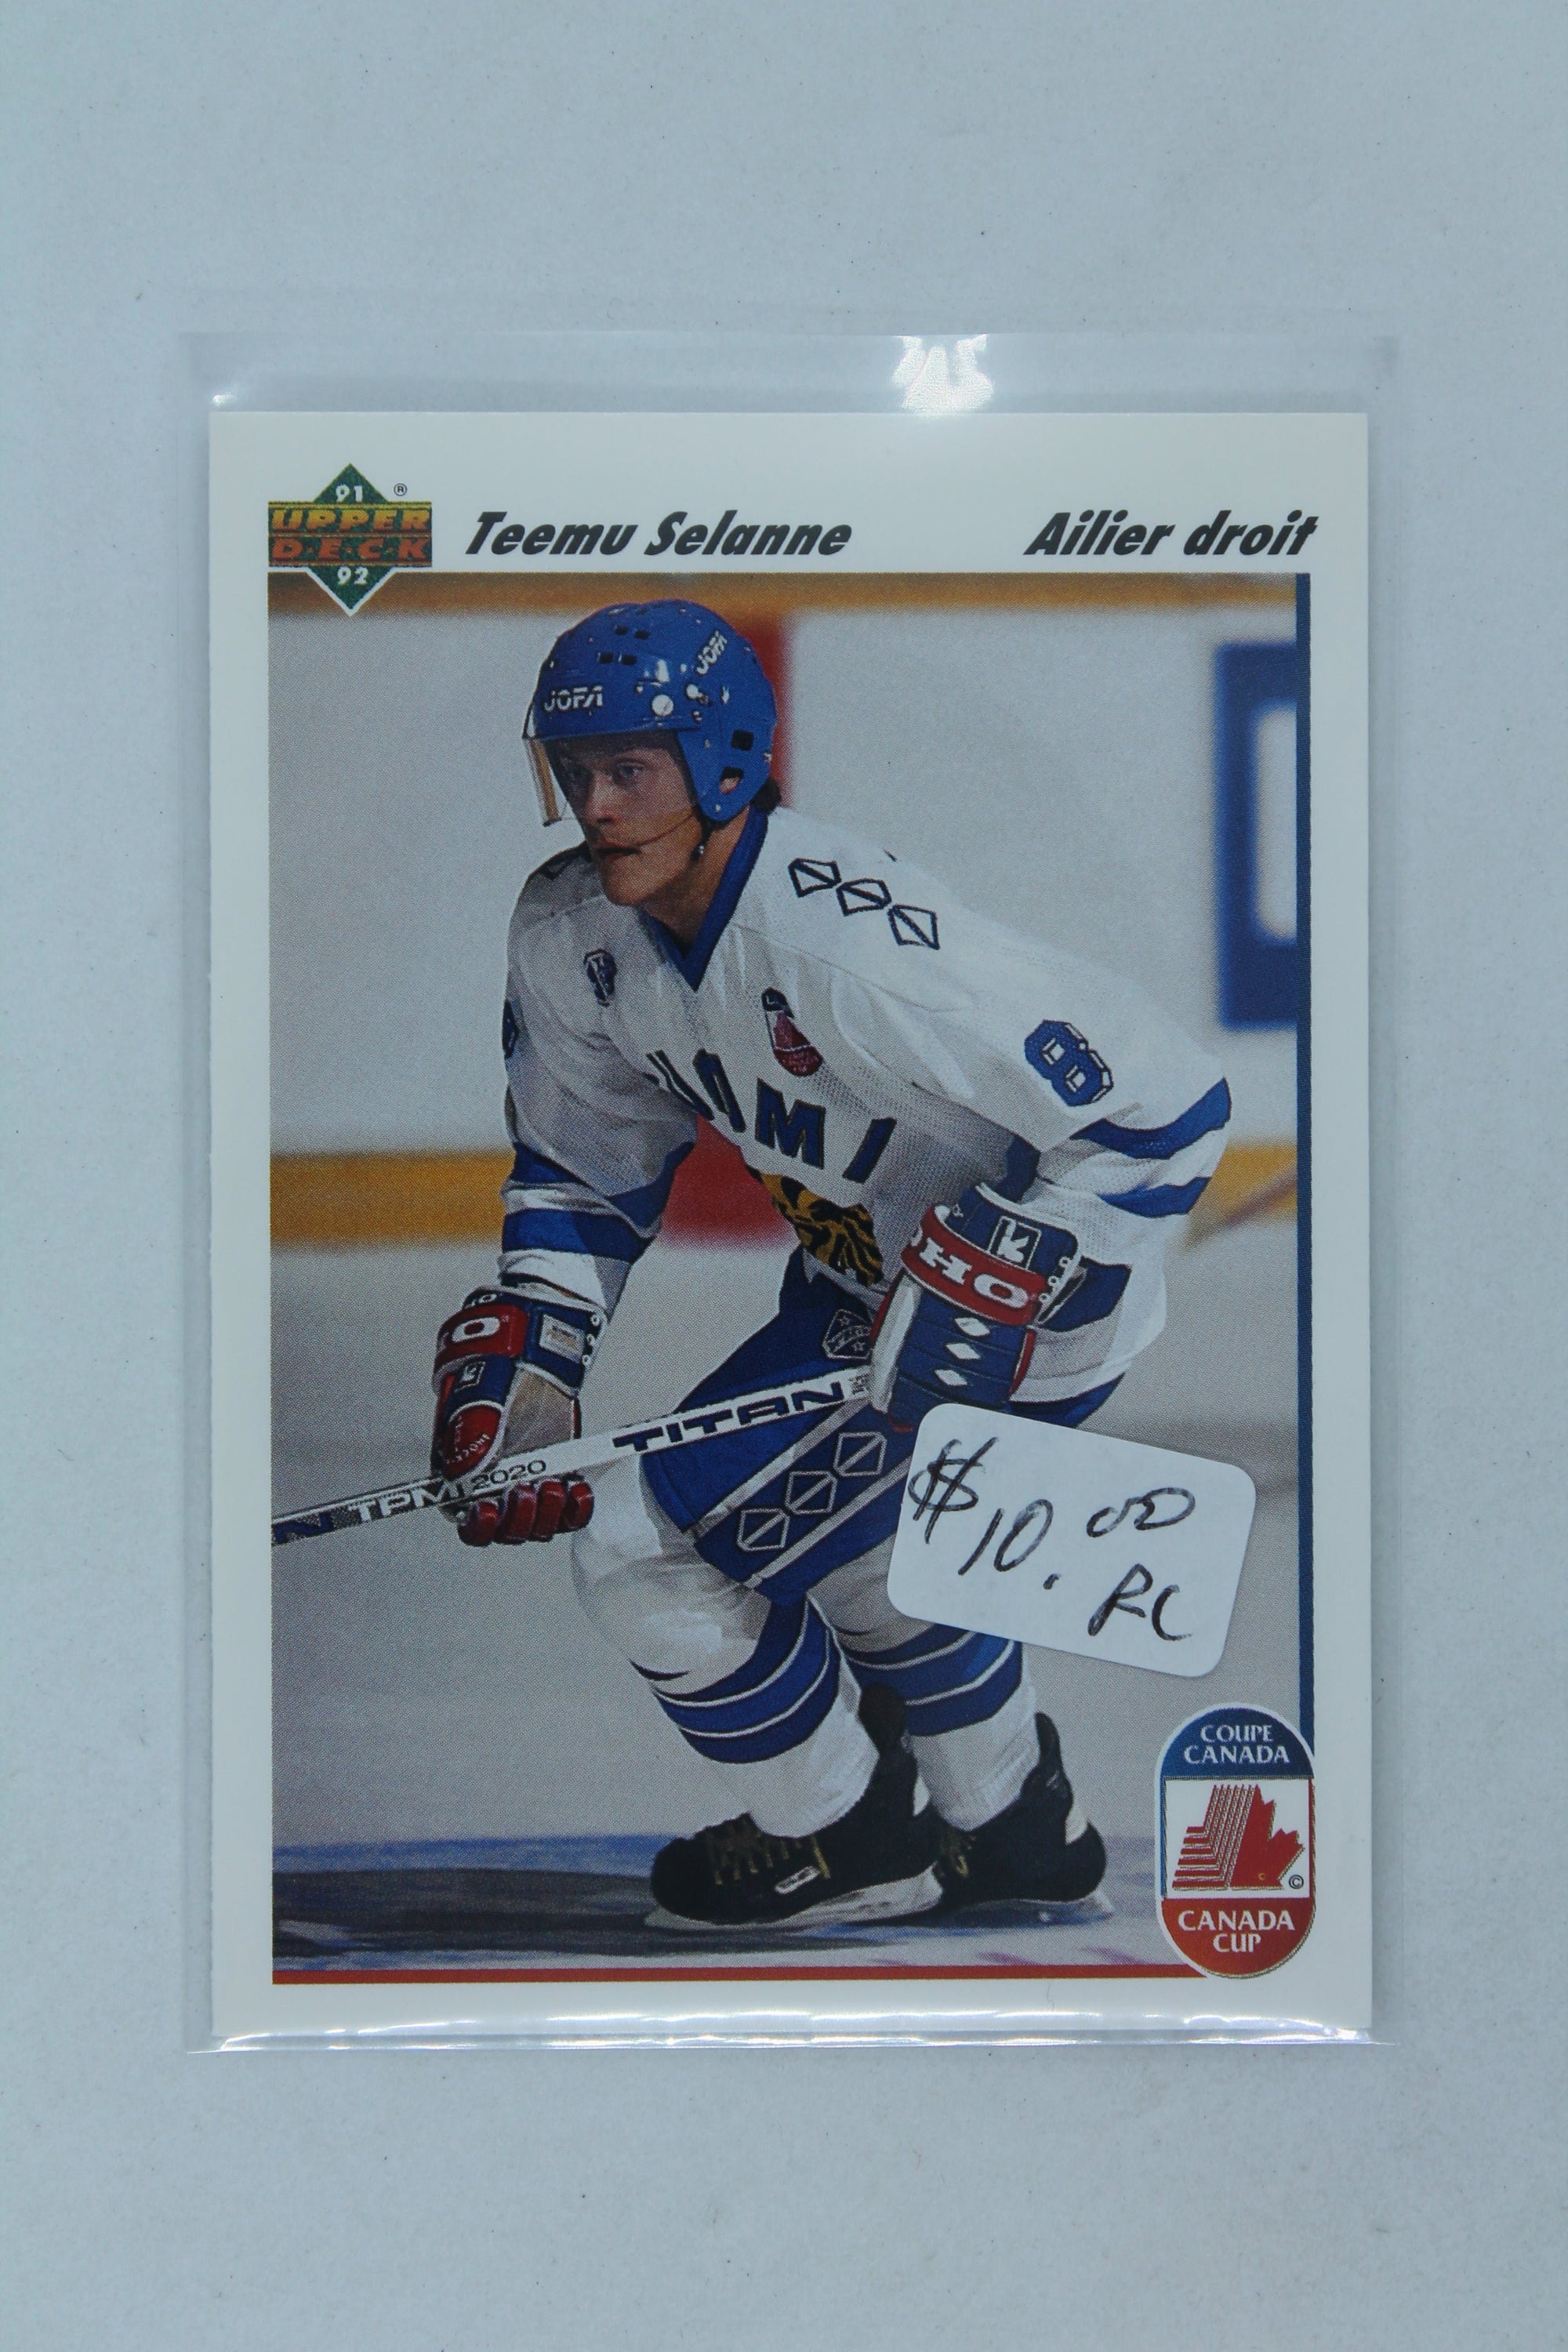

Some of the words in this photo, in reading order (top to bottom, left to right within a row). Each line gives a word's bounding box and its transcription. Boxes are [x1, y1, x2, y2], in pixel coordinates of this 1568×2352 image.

[336, 485, 363, 503] 91
[271, 510, 430, 532] UPPER
[465, 511, 638, 555] Teemu
[644, 509, 852, 555] Selanne
[1022, 510, 1175, 556] Ailier
[1183, 510, 1319, 556] droit
[337, 568, 368, 586] 92
[544, 685, 603, 712] JOFA
[1025, 1020, 1113, 1107] 8
[612, 1381, 844, 1452] TITAN
[470, 1459, 547, 1490] 2020
[1088, 1563, 1193, 1642] RC
[1200, 1725, 1272, 1743] COUPE
[1183, 1745, 1290, 1765] CANADA
[1178, 1910, 1295, 1932] CANADA
[1213, 1933, 1261, 1953] CUP
